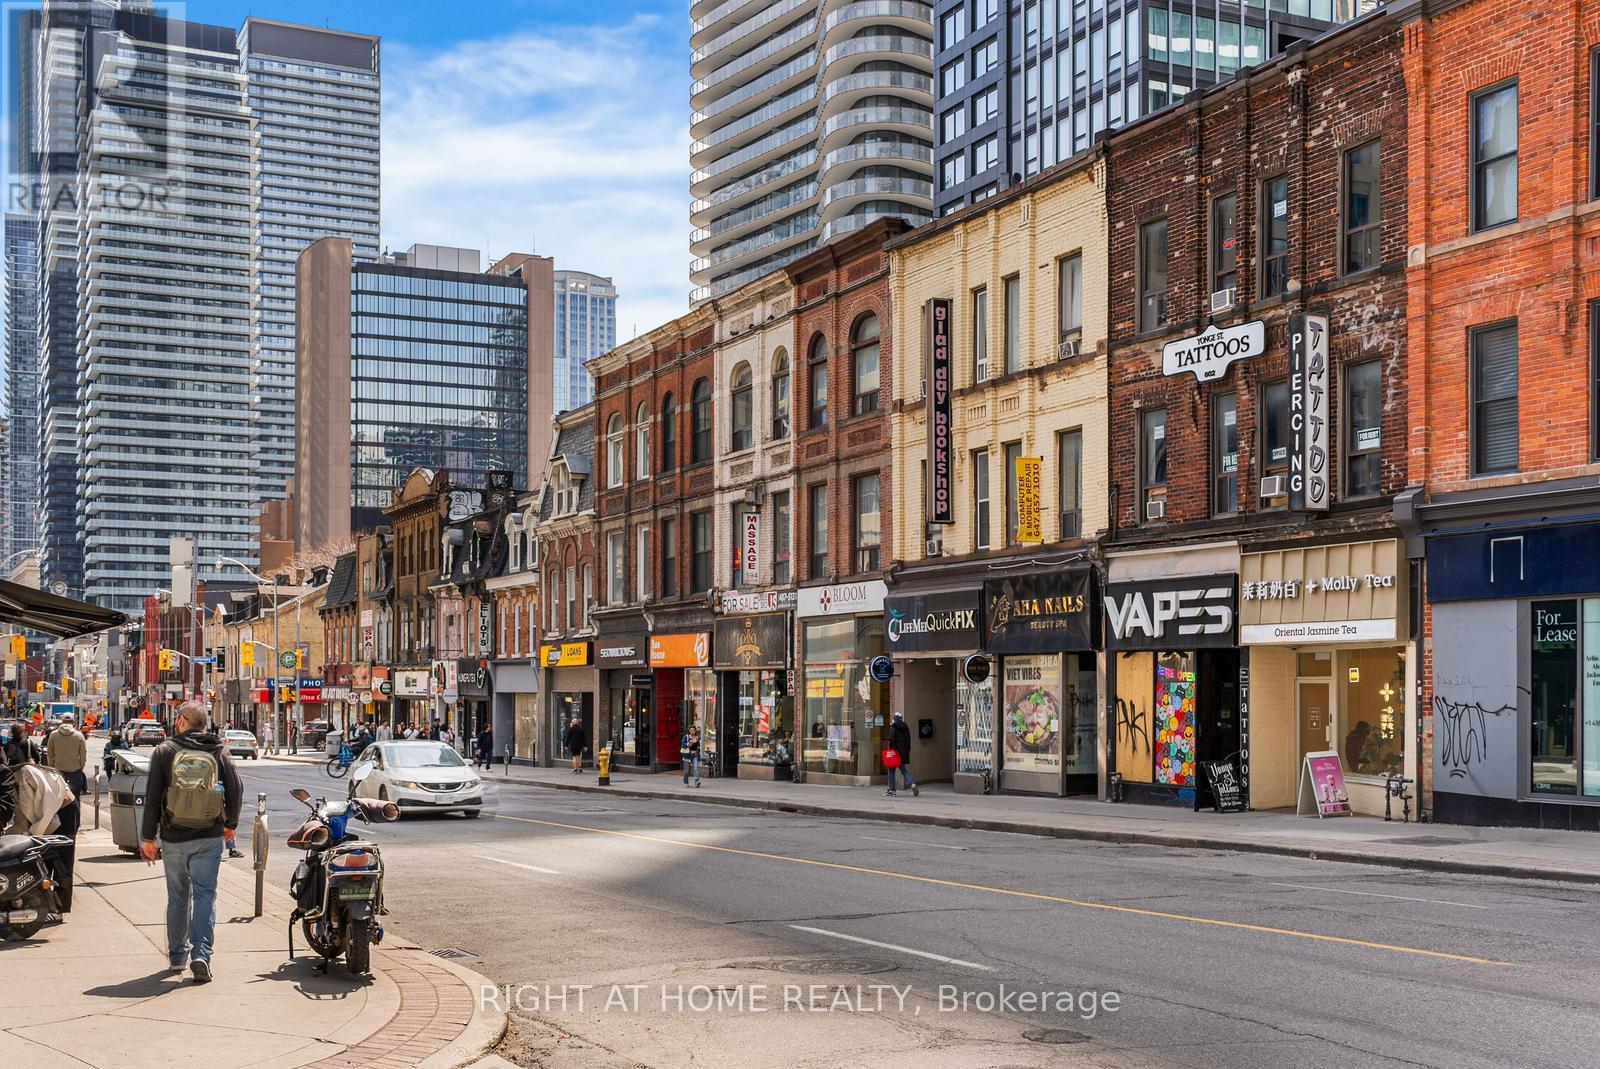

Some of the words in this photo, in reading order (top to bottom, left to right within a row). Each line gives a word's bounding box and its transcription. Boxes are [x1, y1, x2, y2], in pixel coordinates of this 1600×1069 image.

[935, 306, 946, 359] glad
[1197, 333, 1216, 345] YONGE
[1175, 335, 1250, 367] TATTOOS
[935, 367, 947, 405] day
[1291, 333, 1303, 492] PIERCING
[1308, 321, 1326, 504] TATTOO
[936, 411, 947, 514] bookshop
[747, 515, 757, 570] MASSAGE
[1321, 576, 1357, 592] Molly
[1365, 574, 1393, 588] Tea
[833, 585, 866, 602] BLOOM
[723, 598, 738, 612] FOR
[740, 595, 759, 611] SALE
[1013, 599, 1040, 617] AHA
[1045, 595, 1084, 614] NAILS
[1104, 587, 1232, 639] VAPES
[1536, 609, 1561, 625] For
[1030, 620, 1055, 630] BEAUTY
[1274, 627, 1306, 637] Oriental
[1307, 626, 1340, 636] Jasmine
[1341, 625, 1357, 634] Tea
[365, 630, 373, 647] SPA
[1536, 626, 1577, 642] Lease
[284, 653, 293, 666] P
[566, 647, 581, 657] LOANS
[1006, 668, 1021, 681] VIET
[1022, 667, 1041, 680] VIBES
